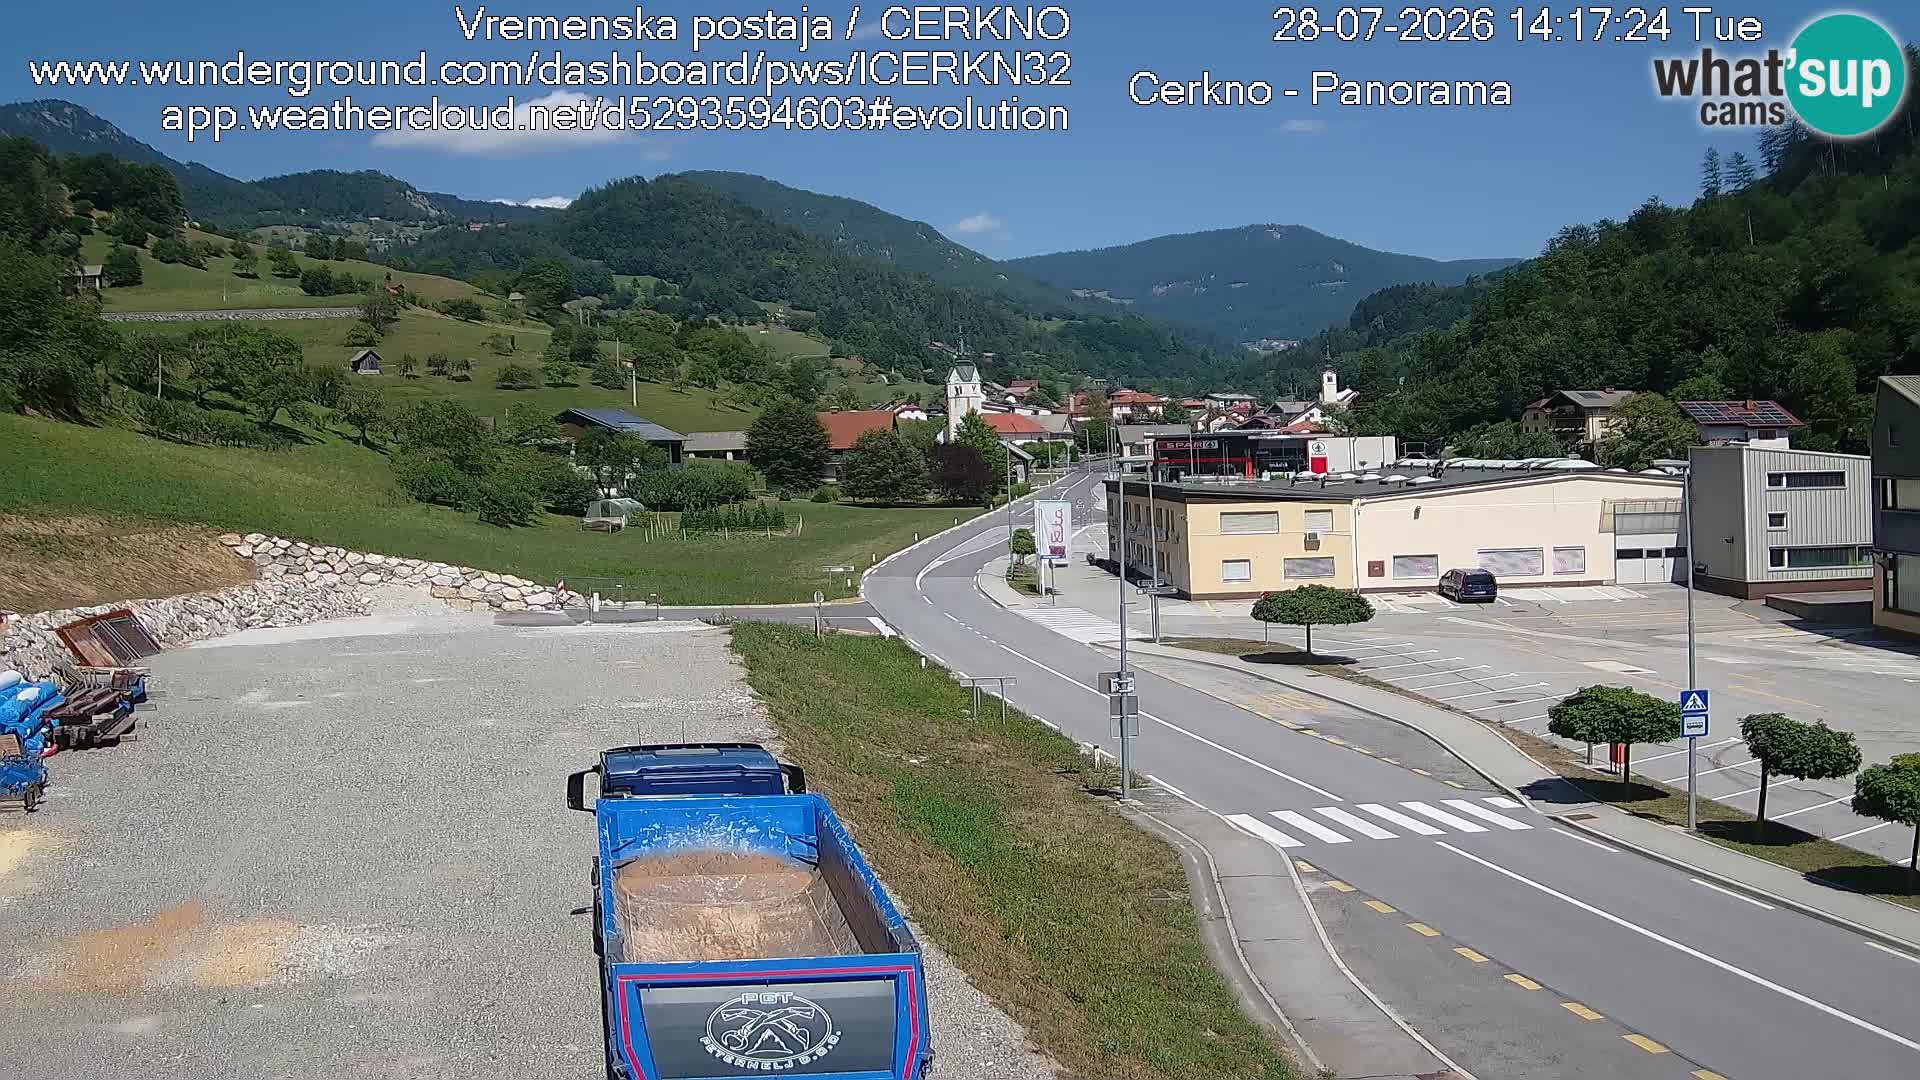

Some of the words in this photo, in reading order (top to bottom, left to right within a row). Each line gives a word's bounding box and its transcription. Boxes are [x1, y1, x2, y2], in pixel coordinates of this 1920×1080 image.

[1166, 441, 1203, 449] SPAR
[741, 991, 794, 1005] PGT
[699, 1036, 794, 1070] PETERNELJ
